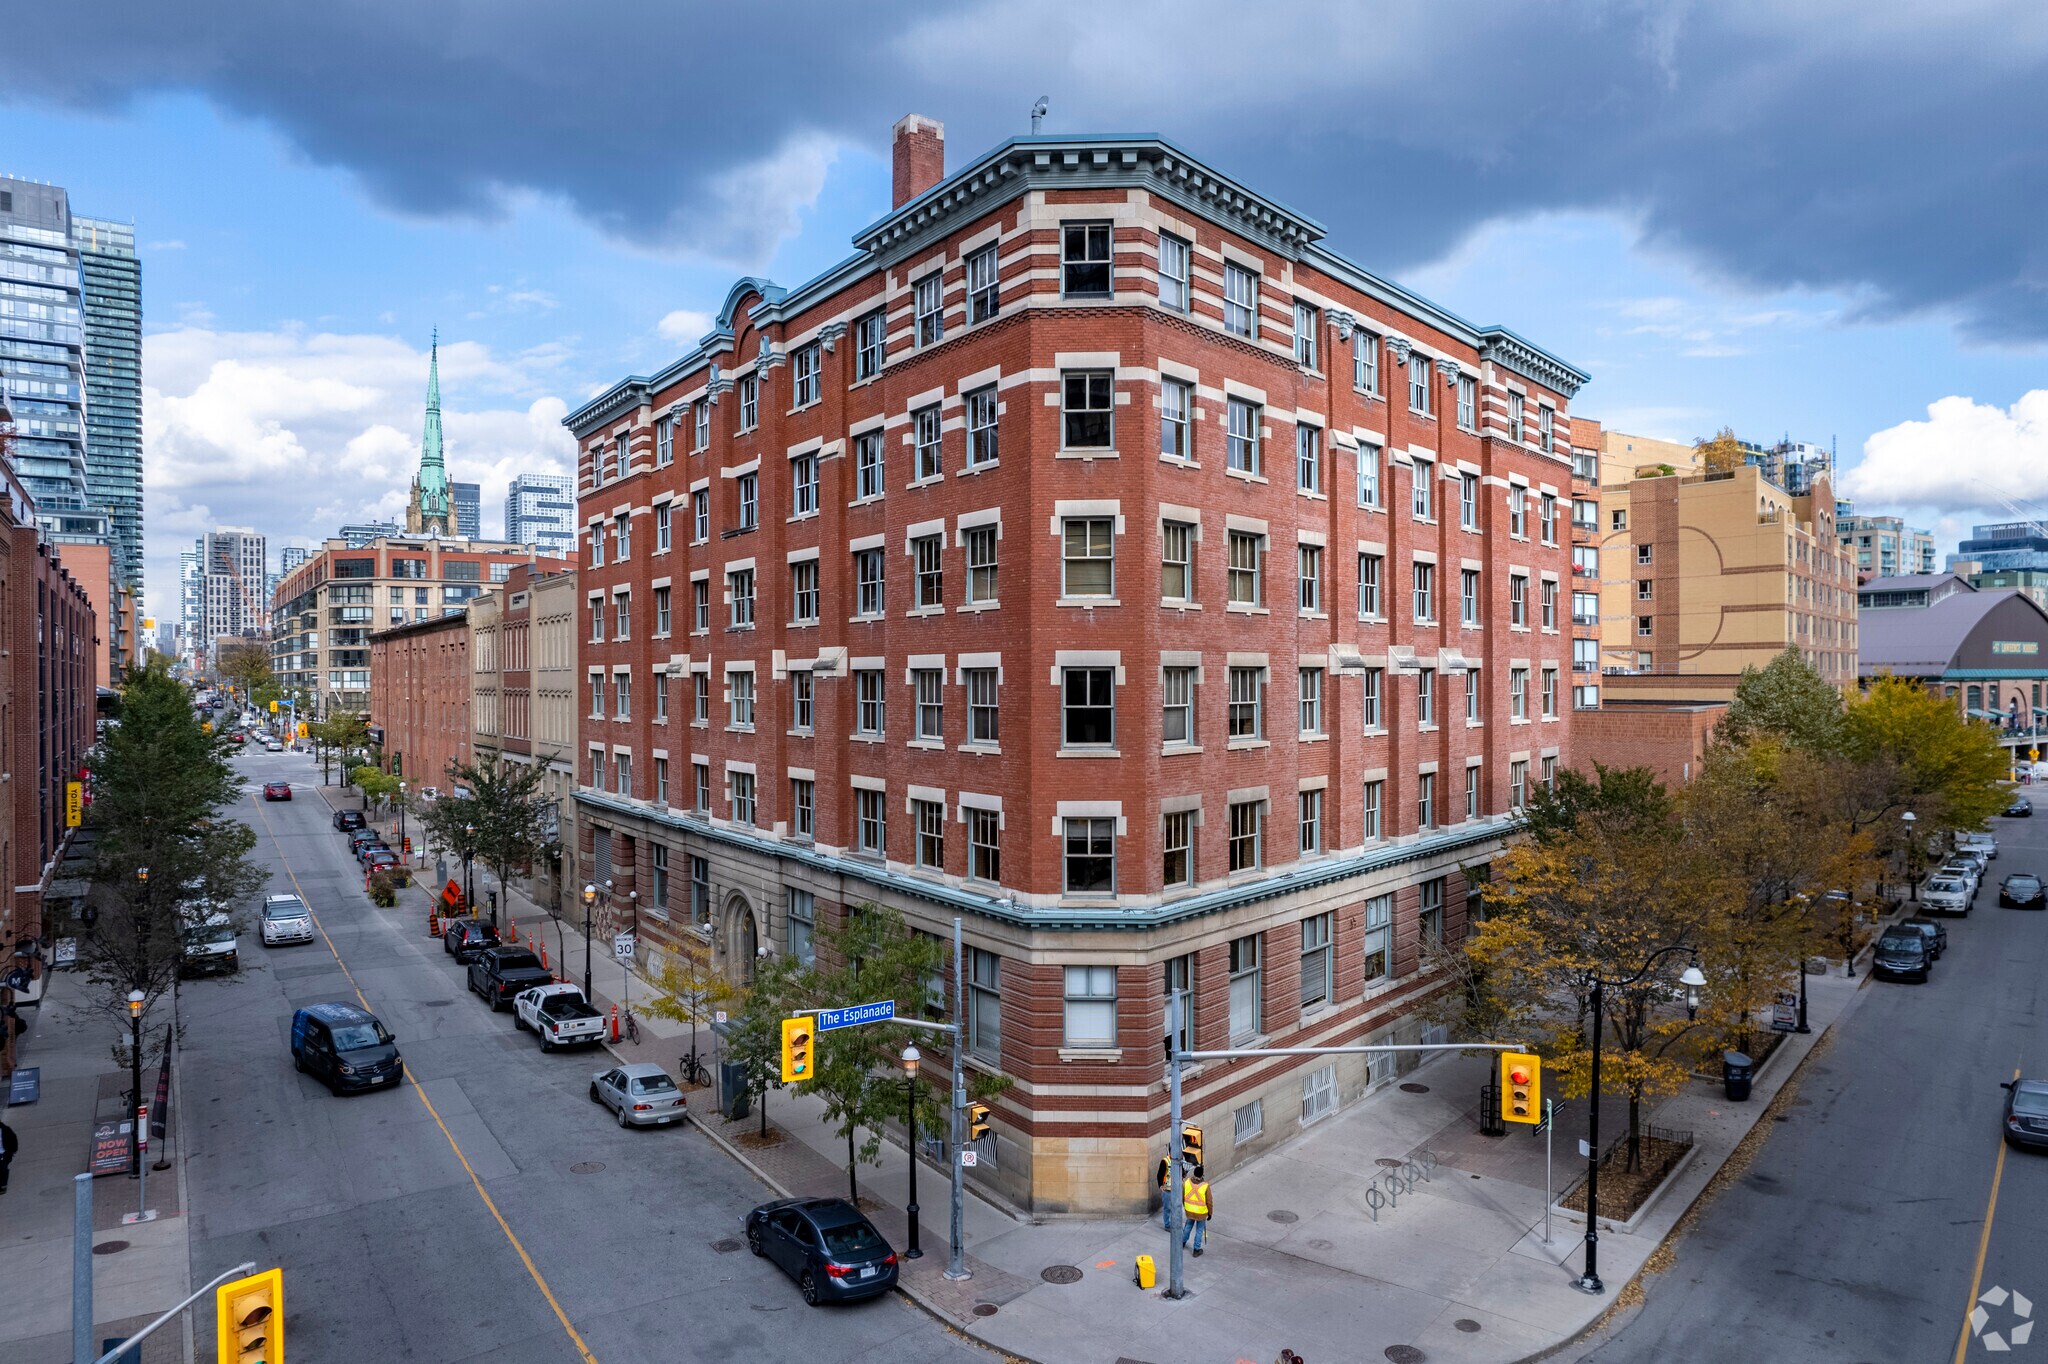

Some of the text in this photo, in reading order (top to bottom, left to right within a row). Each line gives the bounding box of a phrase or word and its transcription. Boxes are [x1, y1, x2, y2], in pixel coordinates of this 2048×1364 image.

[617, 944, 632, 954] 30
[822, 1003, 892, 1026] The Esplanade
[97, 1138, 128, 1150] NOW
[96, 1147, 128, 1159] OPEN
